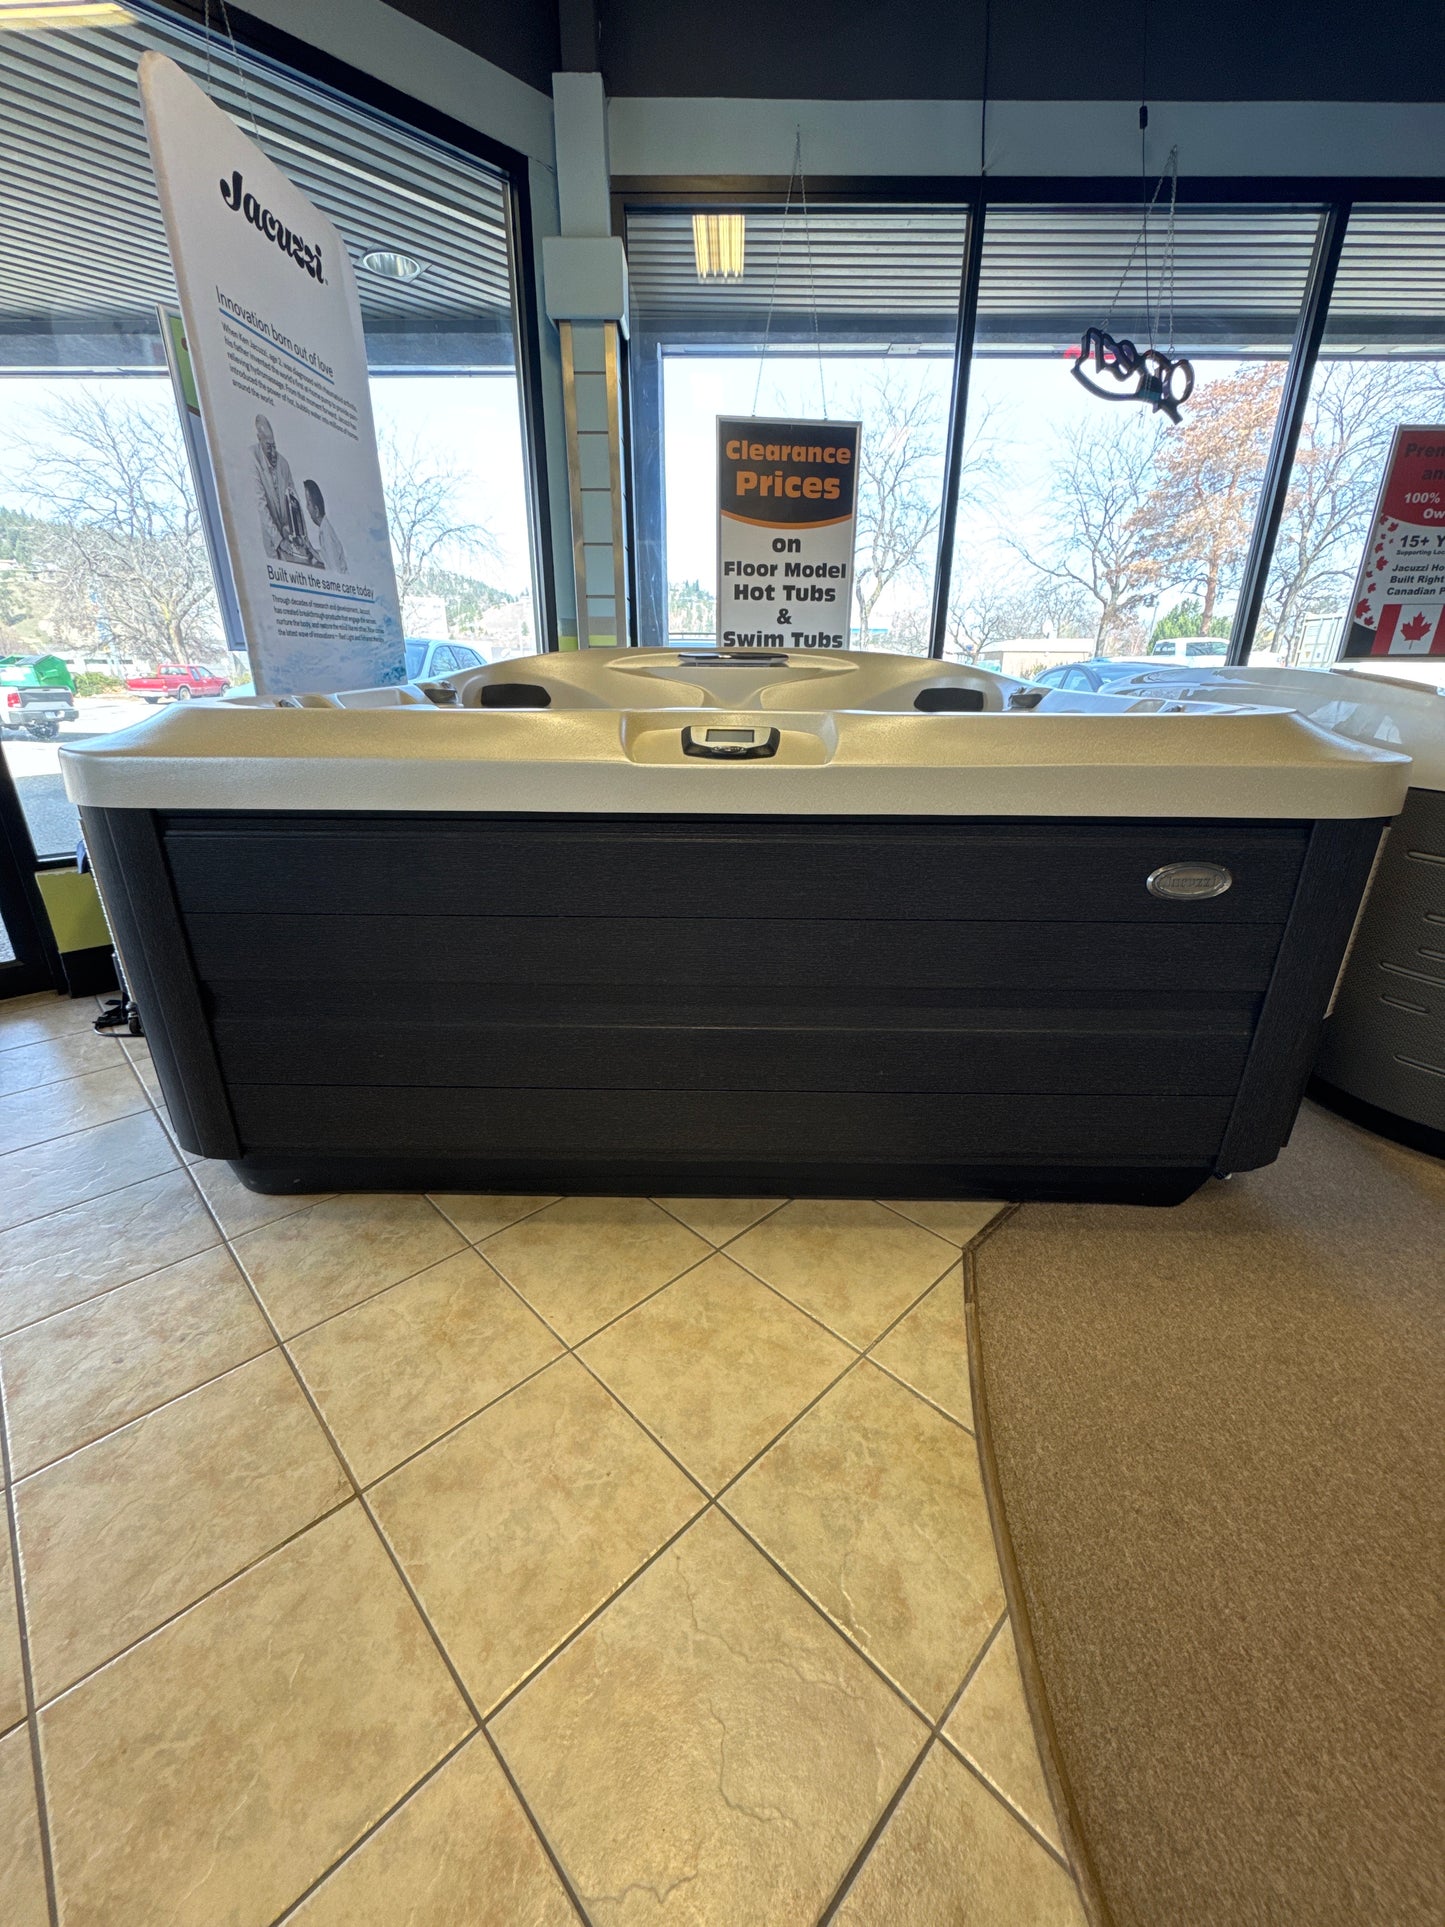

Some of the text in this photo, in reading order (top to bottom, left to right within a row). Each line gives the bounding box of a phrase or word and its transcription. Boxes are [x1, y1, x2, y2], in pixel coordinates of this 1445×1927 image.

[219, 170, 325, 285] Jacuzzi
[215, 285, 334, 378] Innovation born out of love
[726, 439, 851, 464] Clearance
[736, 470, 841, 500] Prices
[1404, 492, 1441, 504] 100%
[772, 537, 801, 553] on
[1400, 534, 1430, 548] 15+
[724, 561, 846, 579] Floor Model
[1391, 563, 1429, 572] Jacuzzi
[267, 564, 374, 600] Built with the same care today
[1390, 575, 1445, 586] Built Right
[734, 584, 836, 602] Hot Tubs
[1386, 586, 1437, 596] Canadian
[777, 608, 792, 625] &
[723, 631, 843, 649] Swim Tubs
